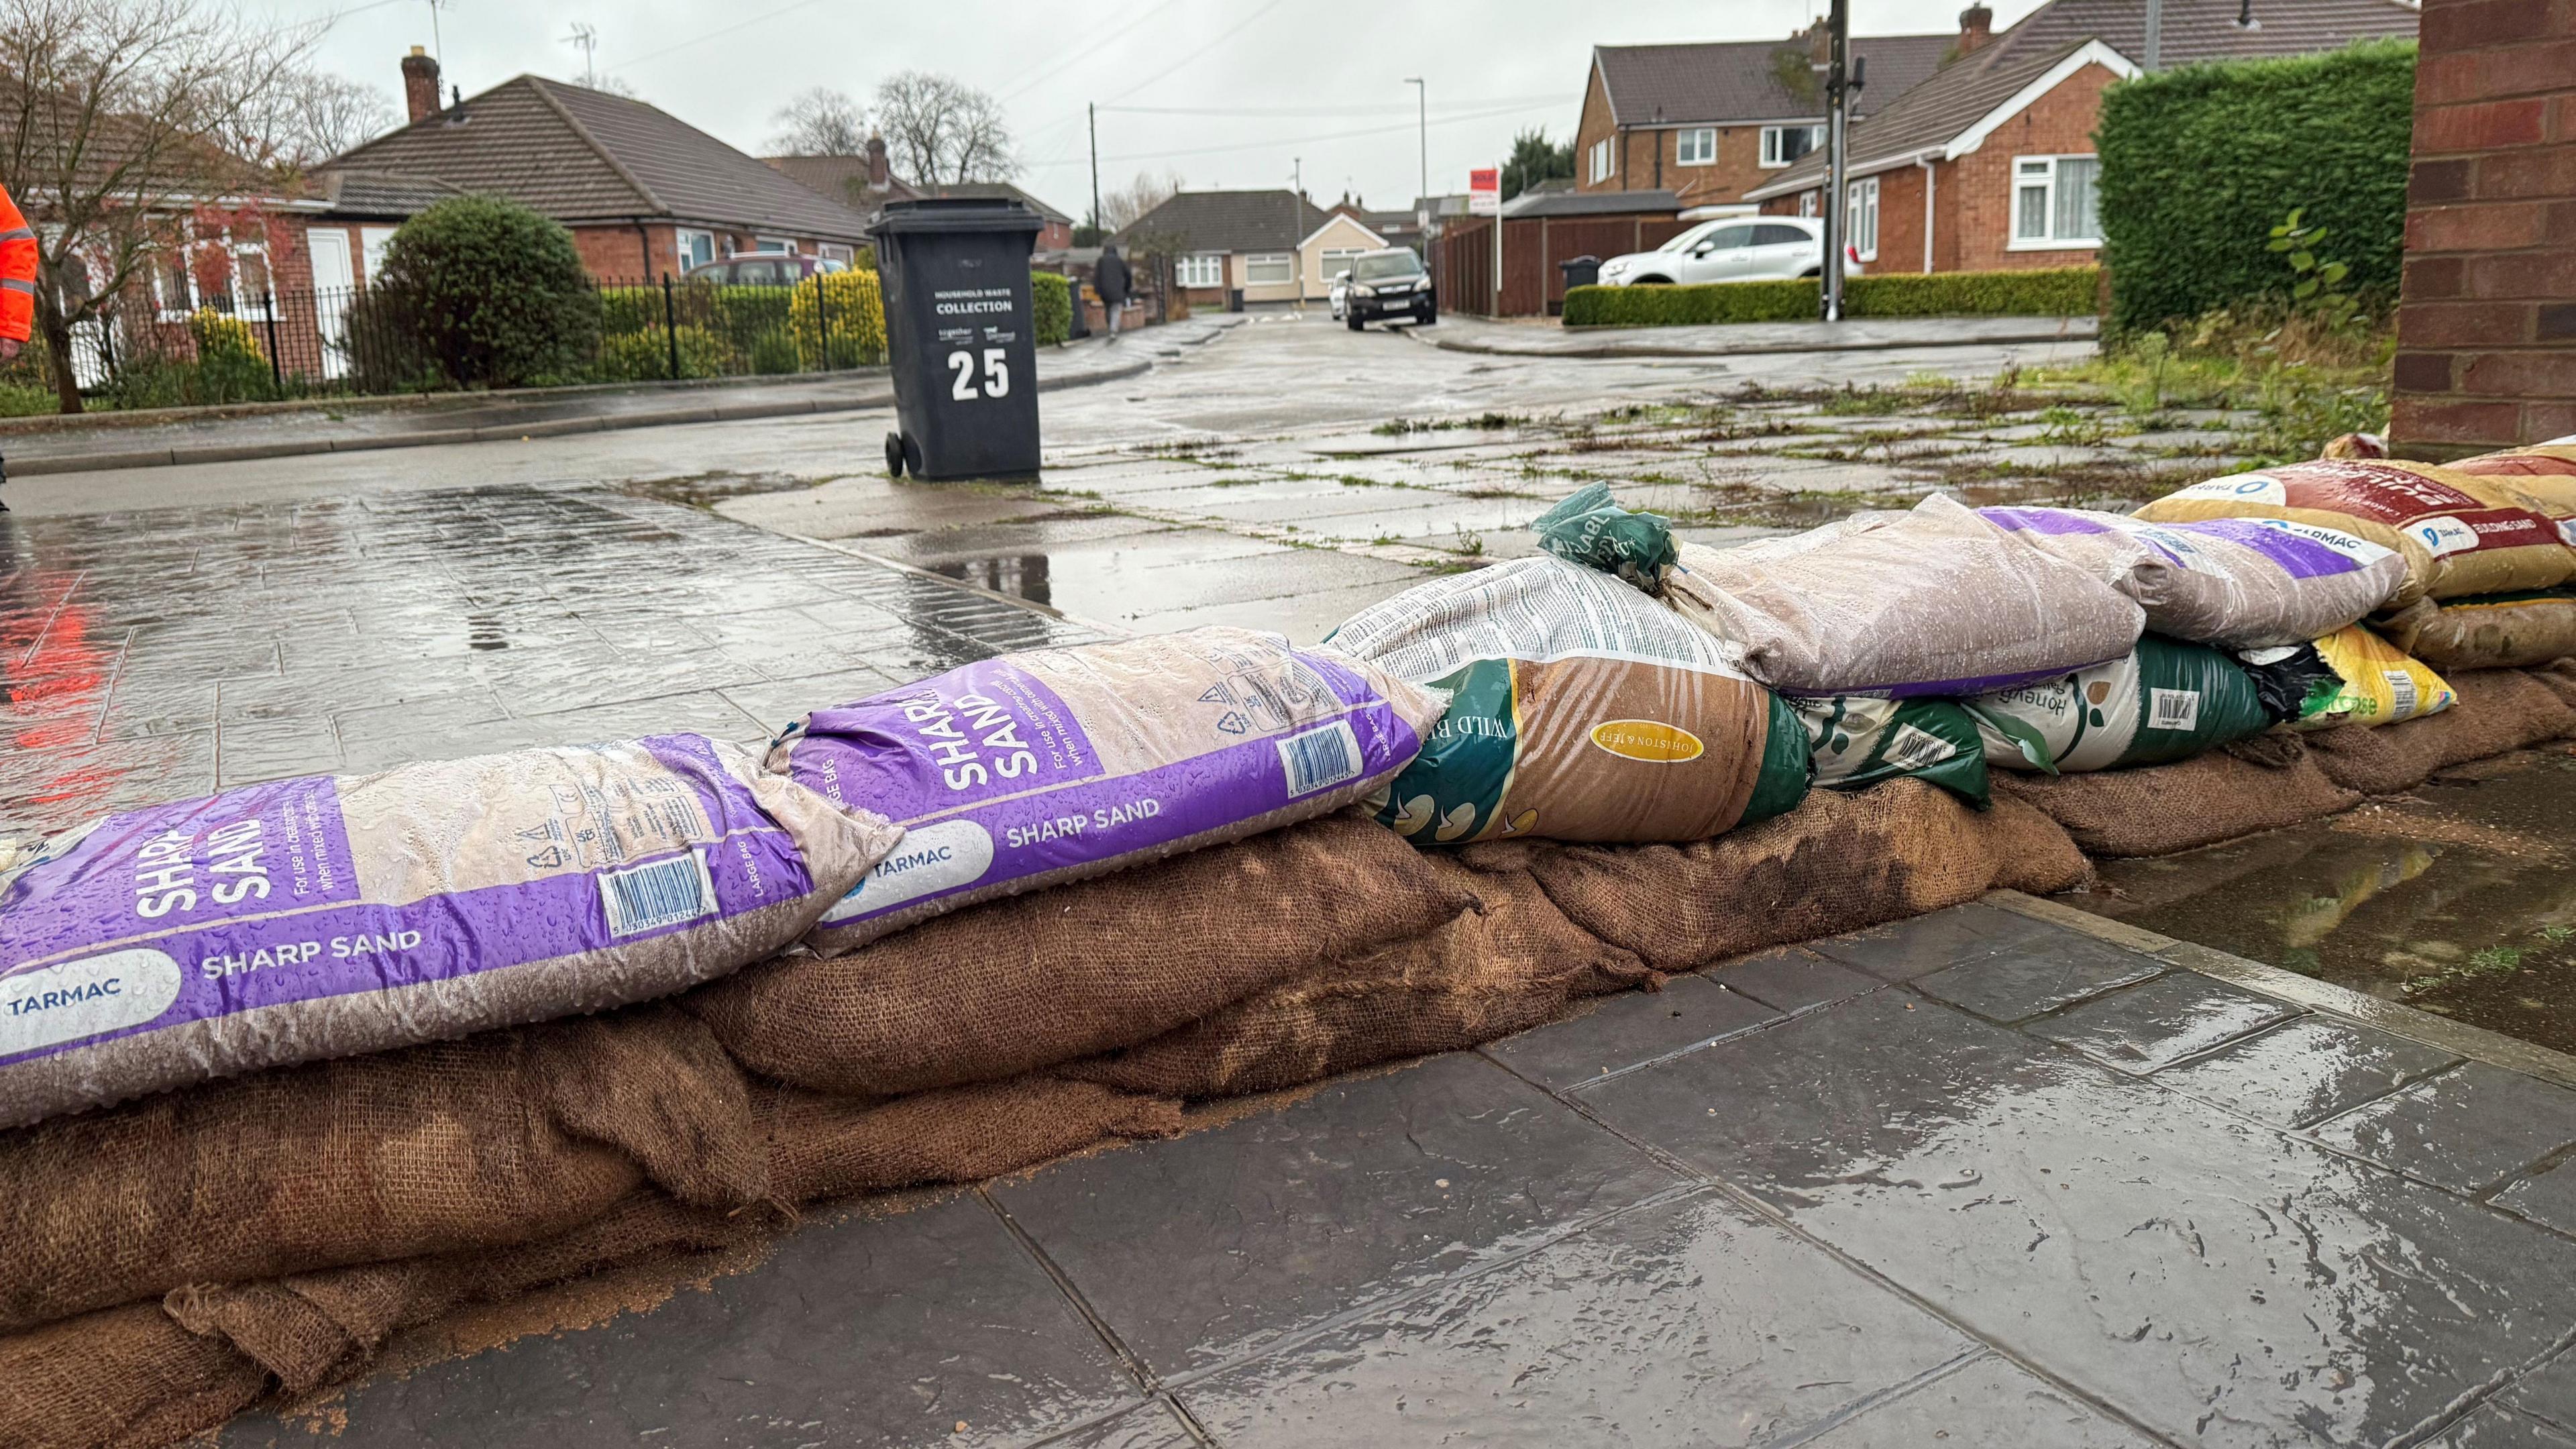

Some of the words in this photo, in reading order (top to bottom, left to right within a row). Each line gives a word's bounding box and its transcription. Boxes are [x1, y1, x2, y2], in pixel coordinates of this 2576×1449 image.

[934, 289, 983, 299] HOUSEHOLD
[984, 288, 1012, 297] WASTE
[936, 301, 1012, 315] COLLECTION
[948, 348, 1009, 401] 25
[1031, 698, 1049, 714] with
[1035, 720, 1046, 730] in
[1042, 710, 1067, 736] mixed
[1458, 716, 1507, 739] WILD
[953, 694, 1038, 778] SAND
[1041, 730, 1056, 749] use
[1600, 732, 1624, 744] JEFF
[1627, 735, 1635, 744] &
[1638, 737, 1695, 753] JOHNSTON
[1051, 751, 1067, 769] For
[1063, 737, 1083, 766] when
[823, 759, 840, 782] BAG
[1008, 814, 1088, 848] SHARP
[1094, 798, 1160, 829] SAND
[286, 845, 302, 855] in
[308, 830, 328, 861] mixed
[738, 841, 751, 859] BAG
[207, 818, 271, 904] SAND
[291, 856, 306, 874] use
[872, 846, 952, 878] TARMAC
[136, 829, 197, 918] SHARP
[317, 862, 333, 892] when
[745, 860, 764, 898] LARGE
[294, 877, 309, 896] For
[626, 916, 663, 932] 030349
[203, 941, 322, 980] SHARP
[330, 930, 421, 959] SAND
[7, 977, 122, 1016] TARMAC
